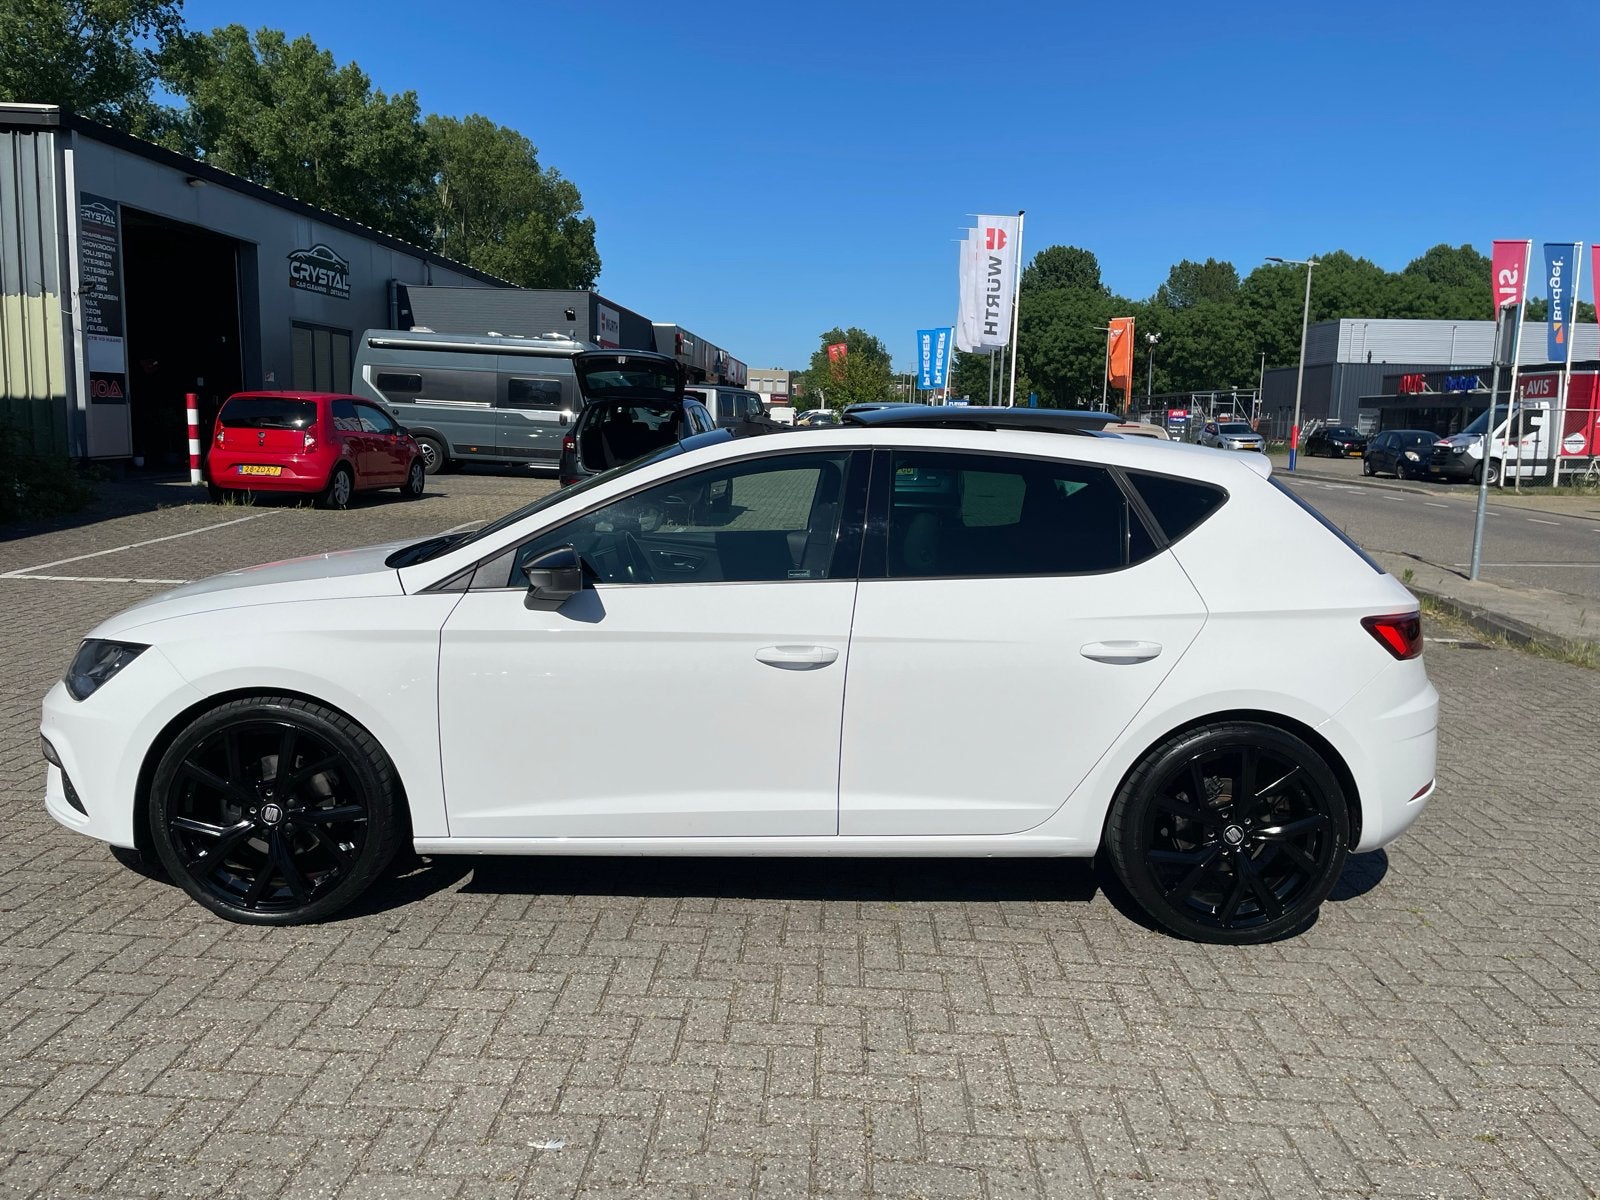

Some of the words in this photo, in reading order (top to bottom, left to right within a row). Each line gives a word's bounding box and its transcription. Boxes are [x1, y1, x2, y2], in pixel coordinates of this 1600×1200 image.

[83, 257, 112, 267] NTERIEUR
[290, 261, 349, 290] CRYSTAL
[1526, 379, 1549, 395] AVIS
